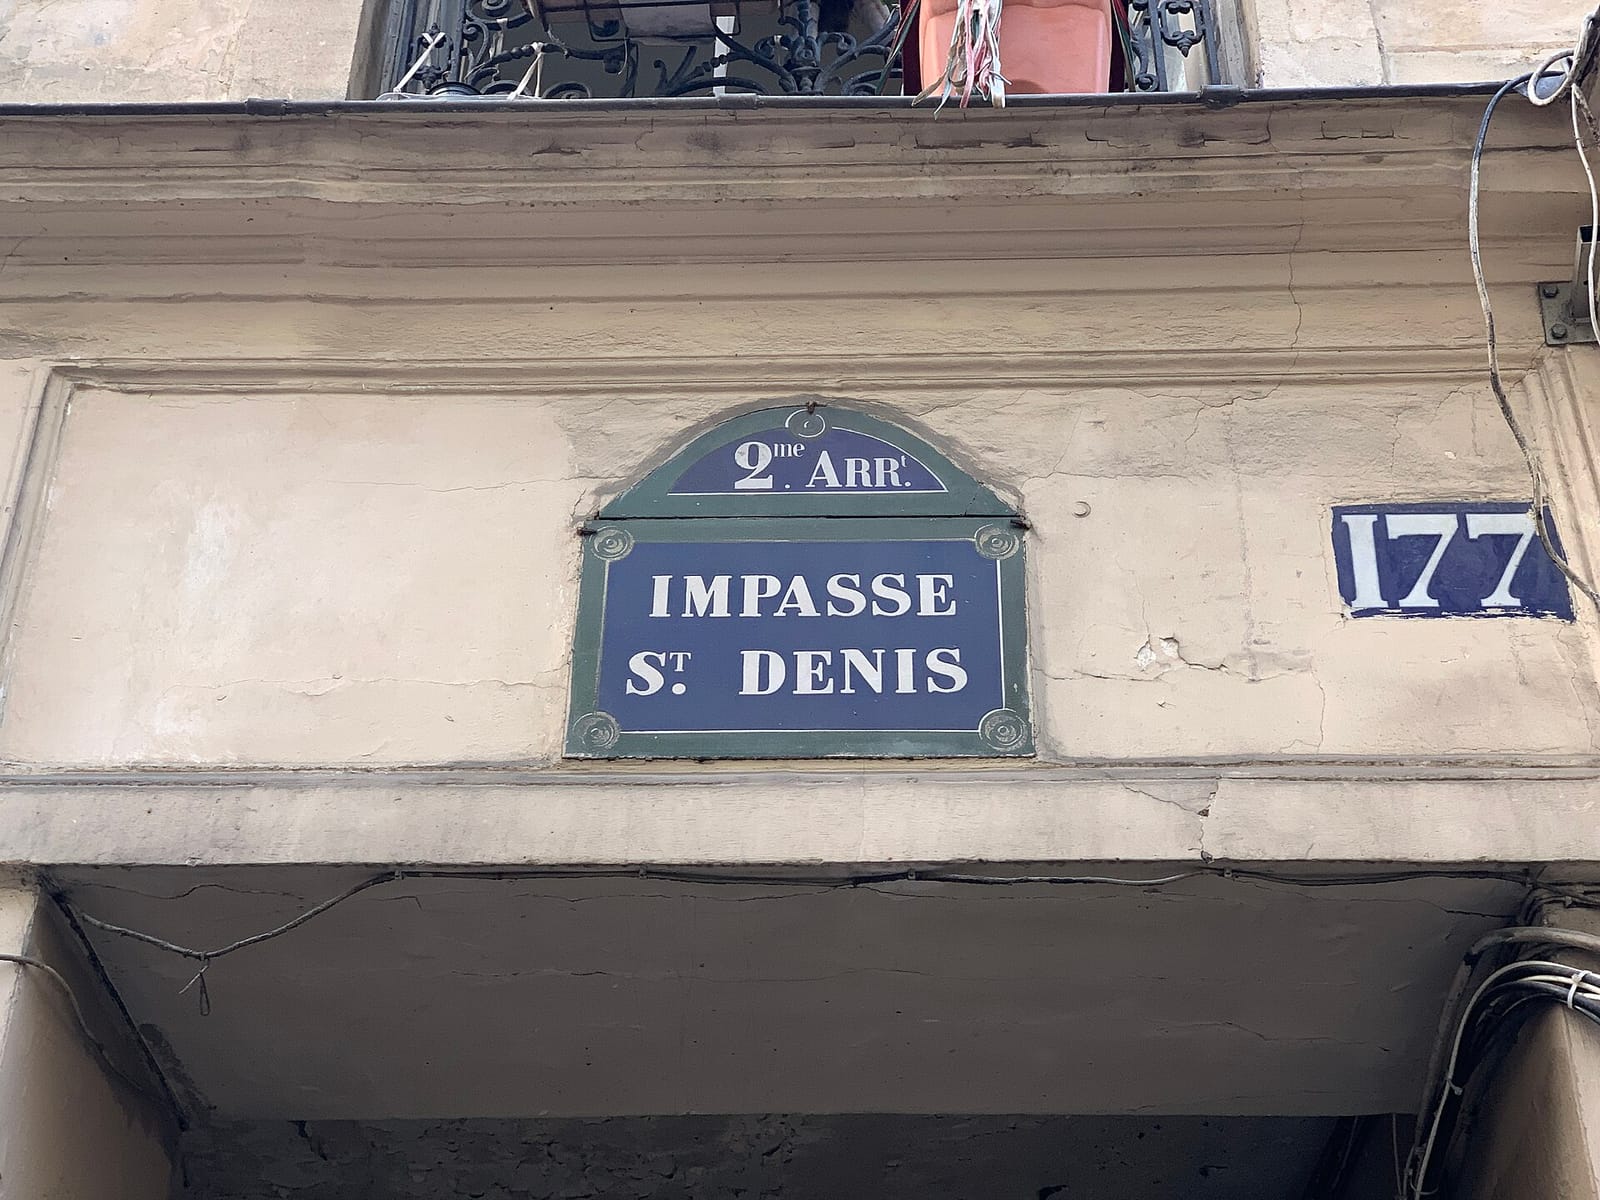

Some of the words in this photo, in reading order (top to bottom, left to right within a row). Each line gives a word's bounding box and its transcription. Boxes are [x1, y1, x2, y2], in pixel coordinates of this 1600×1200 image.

[1340, 512, 1537, 608] 177
[648, 573, 957, 618] IMPASSE
[738, 647, 969, 696] DENIS
